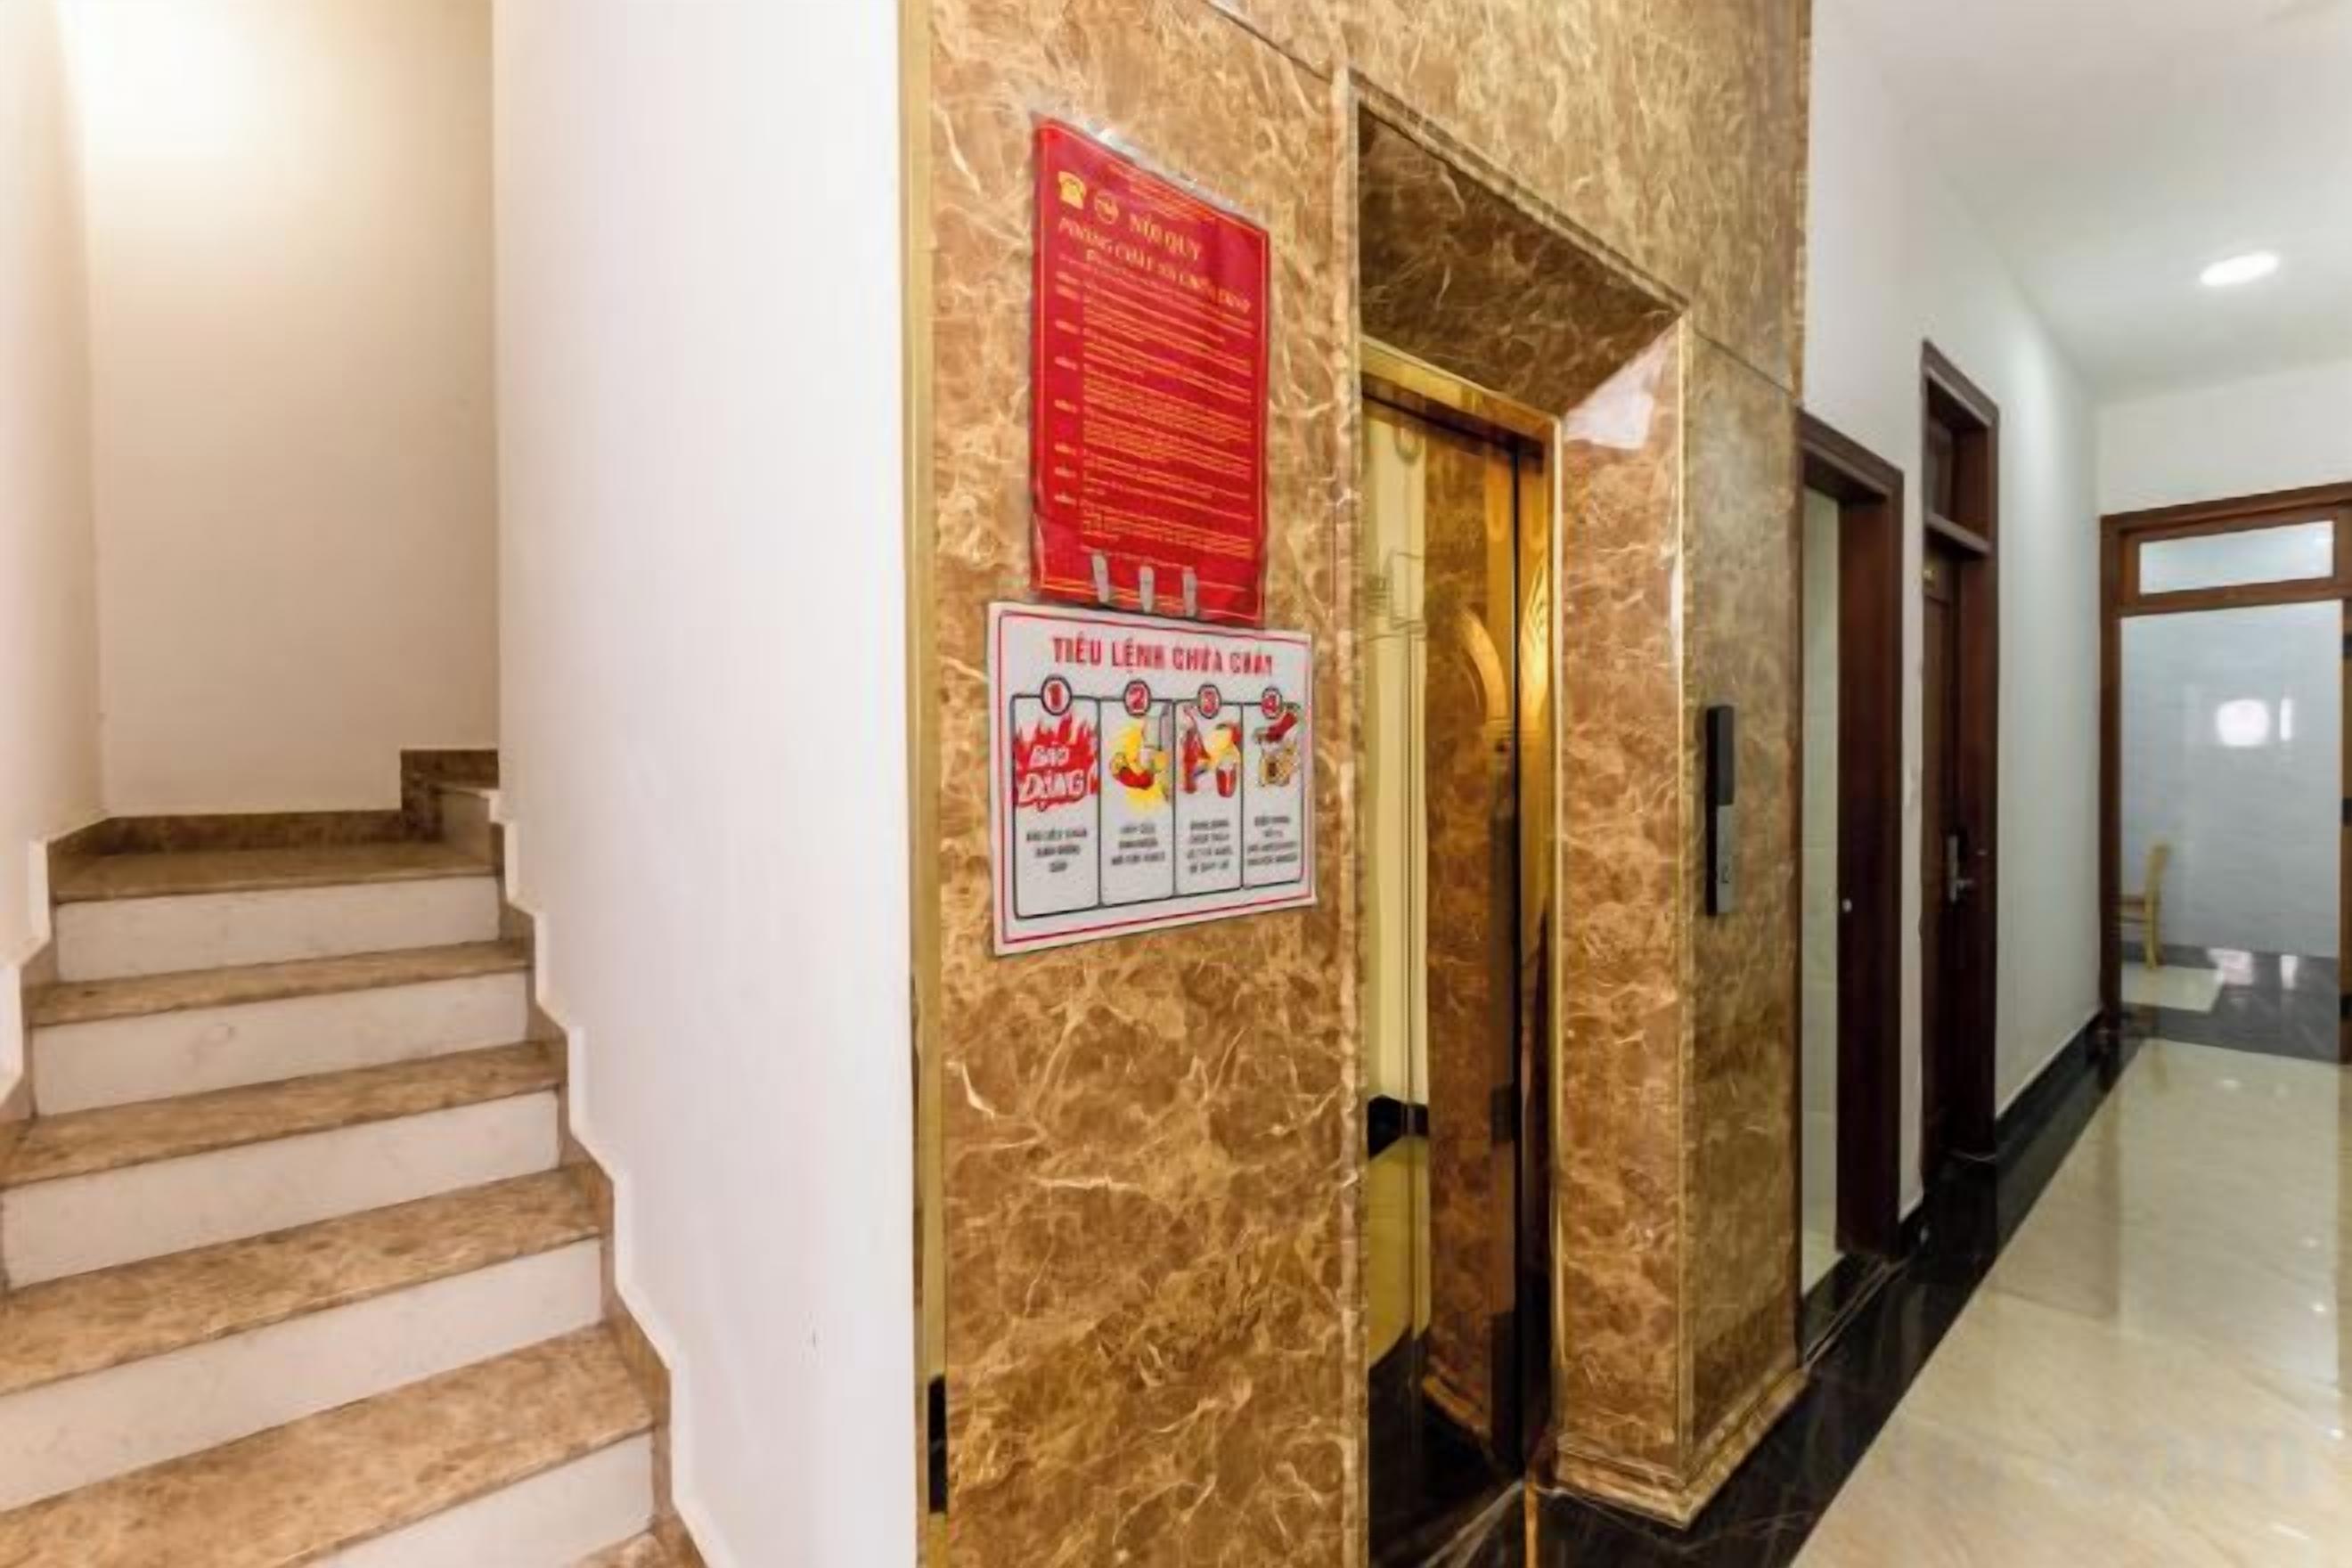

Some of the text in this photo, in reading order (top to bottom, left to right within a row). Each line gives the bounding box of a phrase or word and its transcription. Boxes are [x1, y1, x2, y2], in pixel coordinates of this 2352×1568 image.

[1053, 631, 1102, 666] TIÊU
[1049, 682, 1062, 709] 1
[1129, 686, 1146, 711] 2
[1202, 689, 1215, 715] 3
